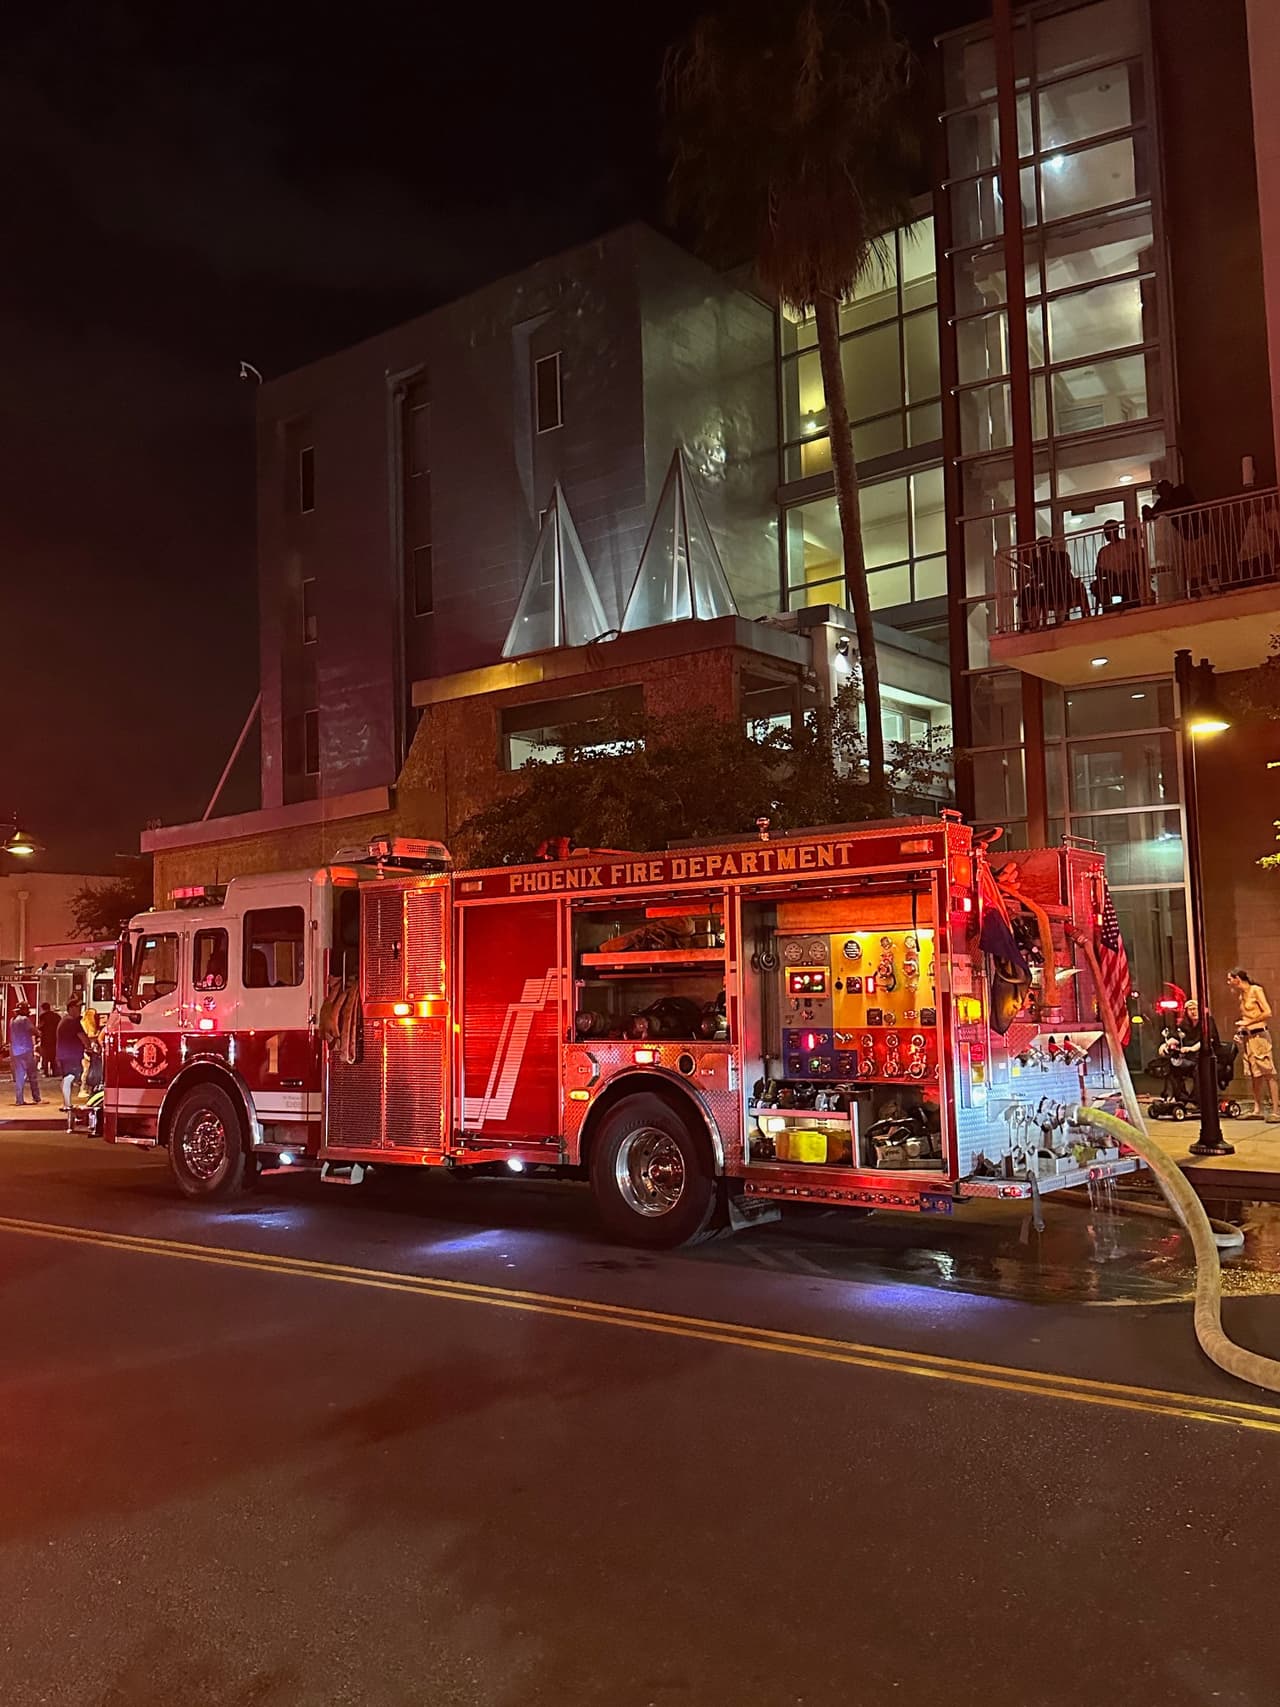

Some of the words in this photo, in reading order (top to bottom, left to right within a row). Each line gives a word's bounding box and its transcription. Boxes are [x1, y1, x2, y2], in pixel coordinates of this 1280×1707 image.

[509, 866, 603, 893] PHOENIX
[611, 860, 664, 885] FIRE
[671, 843, 853, 880] DEPARTMENT
[265, 1034, 279, 1074] 1
